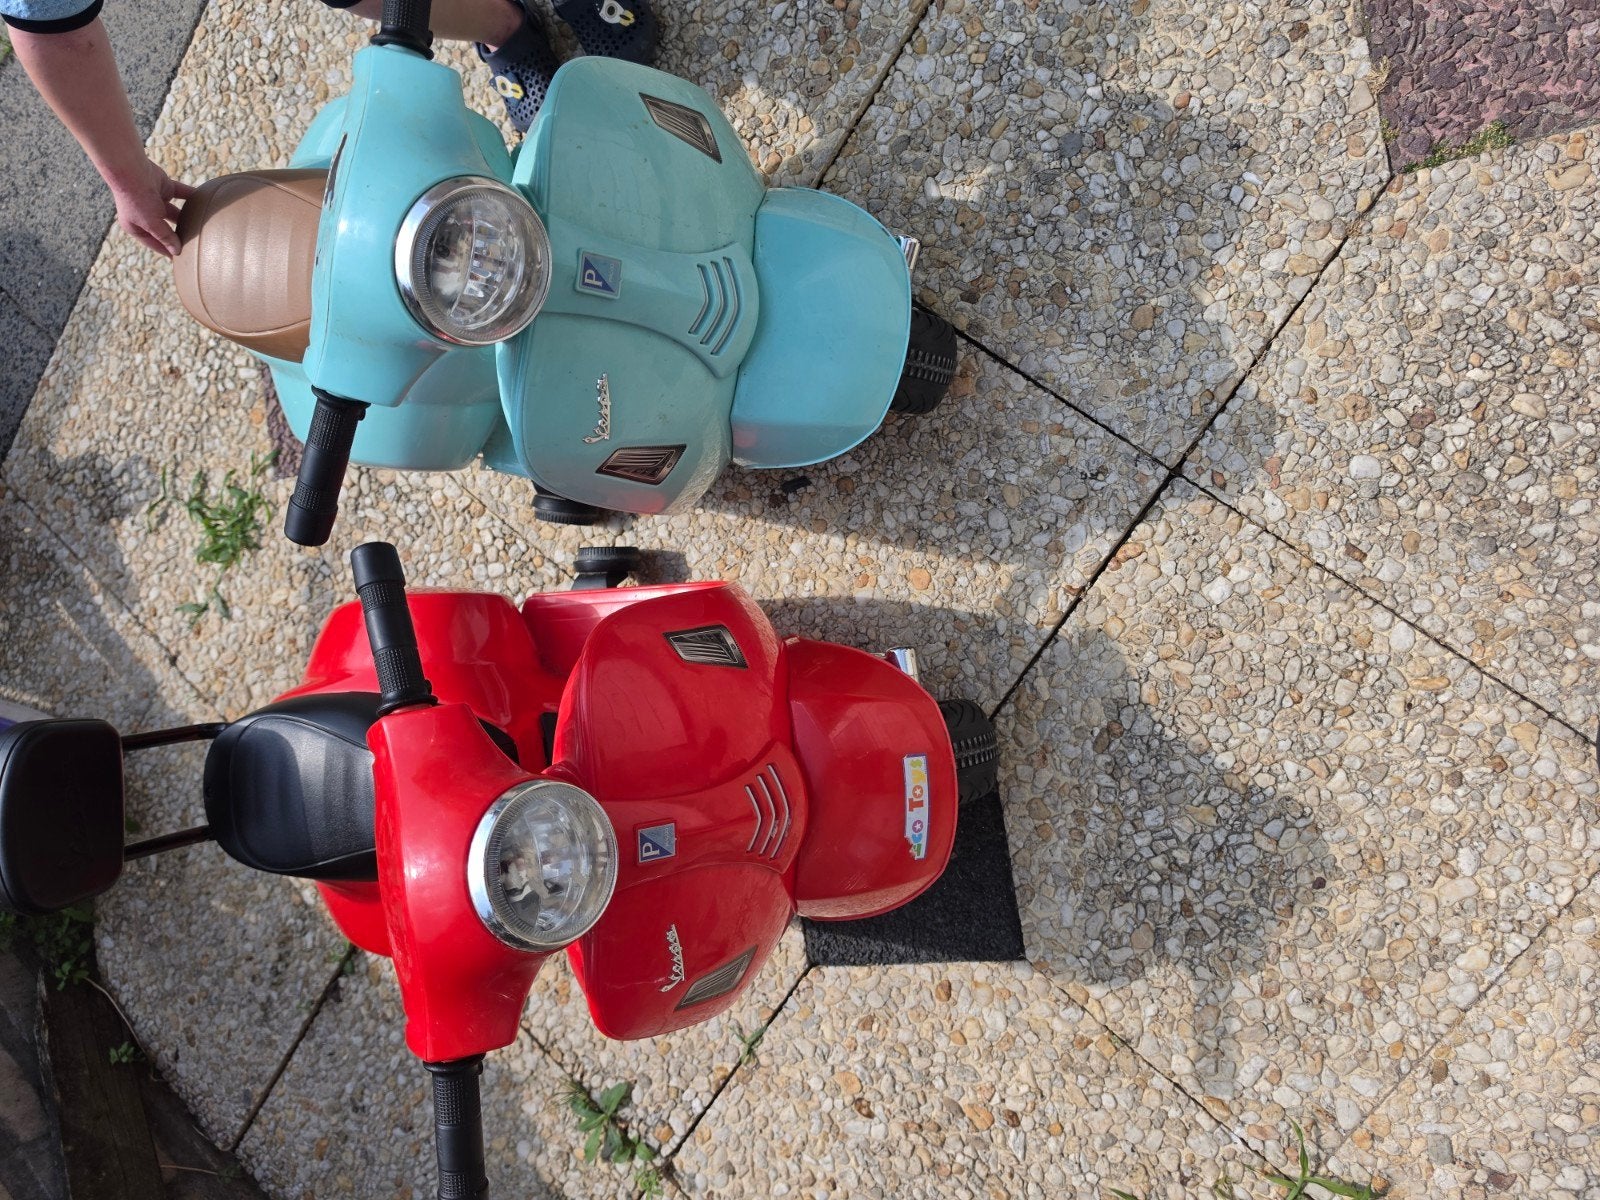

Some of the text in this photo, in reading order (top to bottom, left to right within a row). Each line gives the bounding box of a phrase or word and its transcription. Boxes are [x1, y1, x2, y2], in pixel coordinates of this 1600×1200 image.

[584, 269, 603, 287] P
[642, 842, 660, 858] P
[660, 923, 685, 993] Vespa
